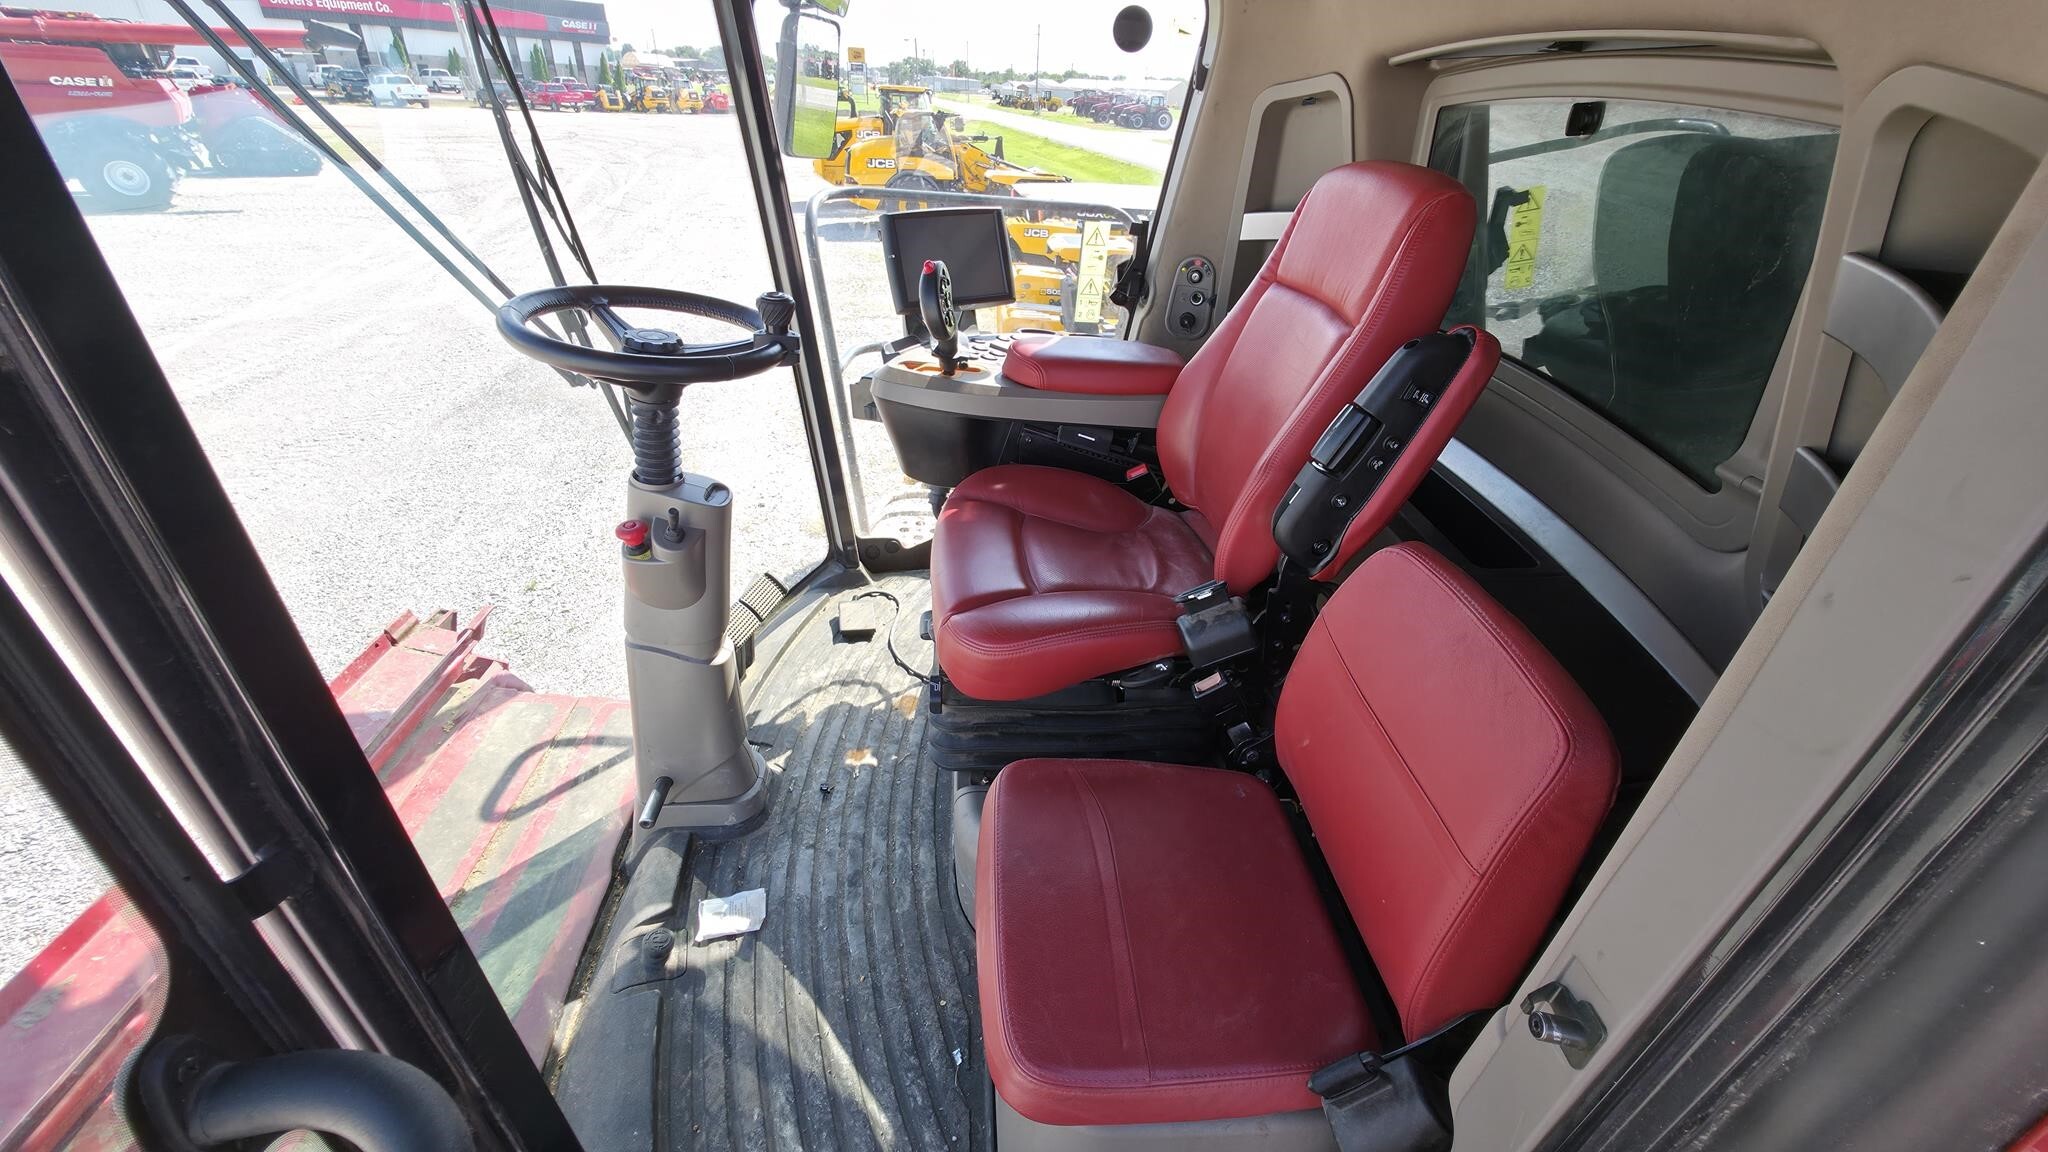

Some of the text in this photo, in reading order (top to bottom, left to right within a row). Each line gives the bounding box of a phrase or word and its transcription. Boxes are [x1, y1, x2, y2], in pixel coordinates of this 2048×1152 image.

[316, 0, 375, 12] Equipment
[375, 1, 394, 14] Co.
[561, 20, 588, 29] CASE
[49, 76, 97, 86] CASE
[857, 130, 881, 139] JCB
[868, 159, 896, 168] JCB
[1024, 229, 1049, 237] JCB
